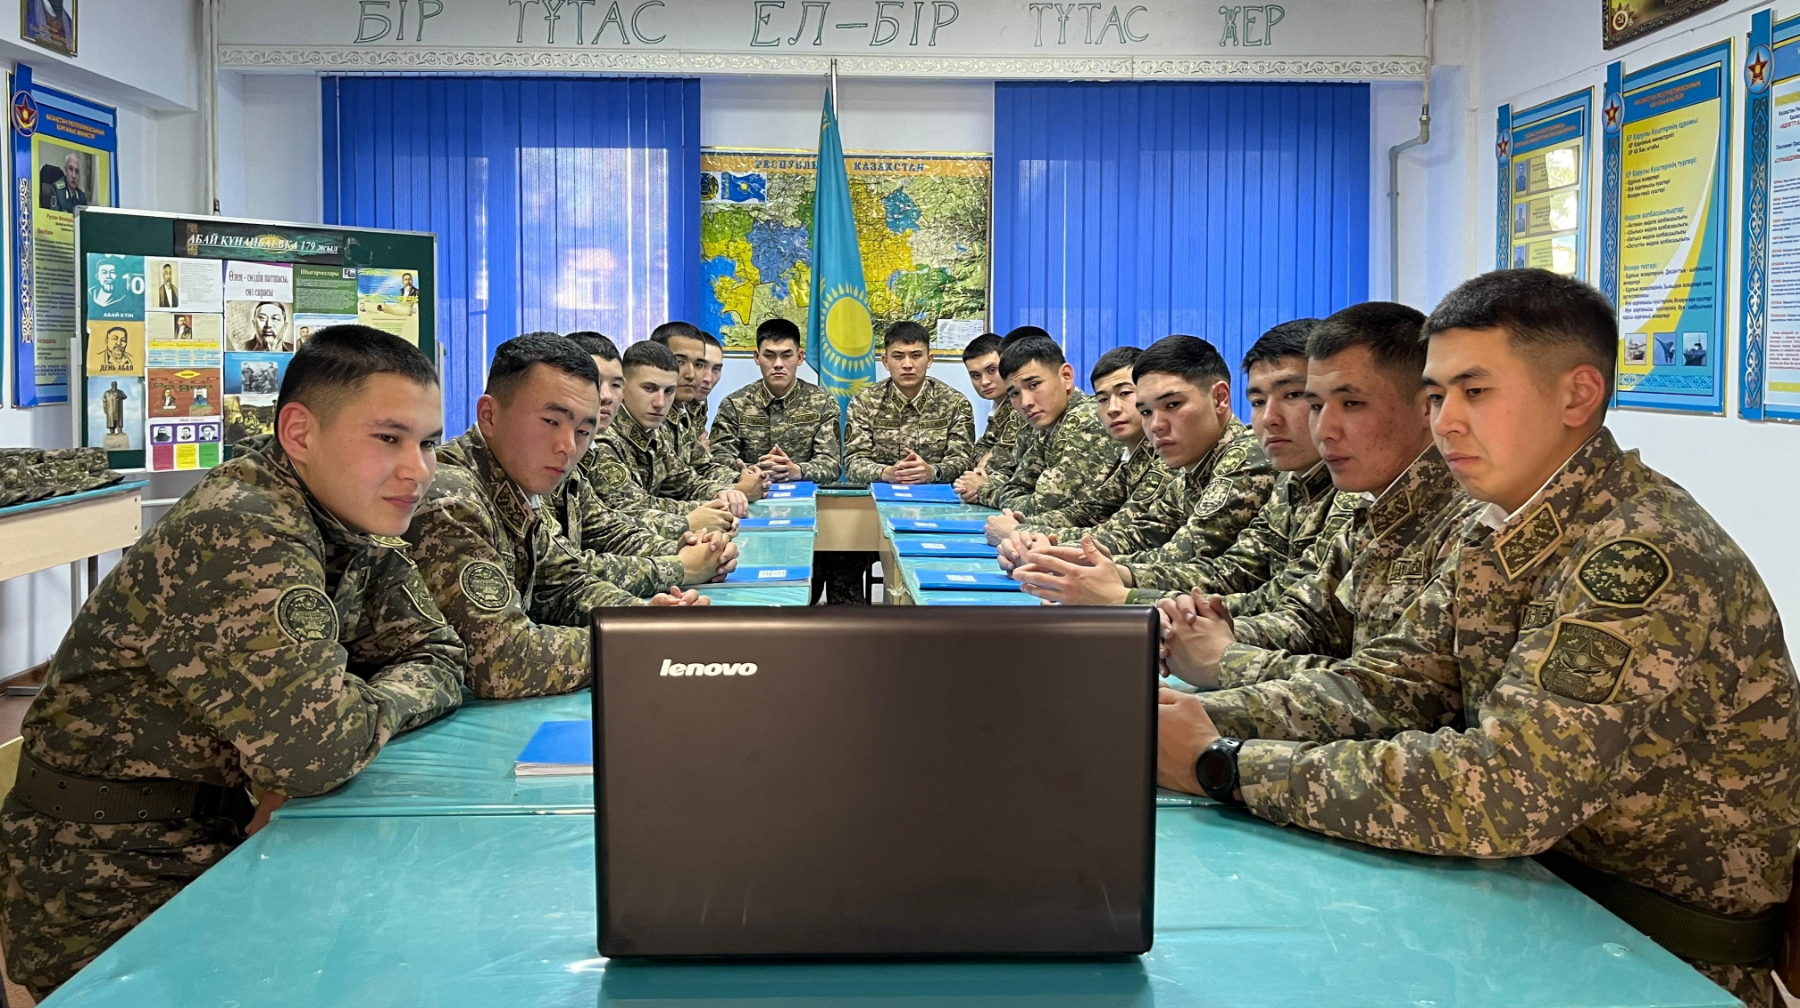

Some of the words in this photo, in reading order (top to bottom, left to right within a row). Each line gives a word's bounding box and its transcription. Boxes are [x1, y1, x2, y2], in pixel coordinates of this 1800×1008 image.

[353, 0, 444, 43] БІР
[508, 0, 666, 45] ТҰТАС
[1029, 3, 1149, 47] ТҰТАС
[755, 159, 818, 170] РЕСПУБЛИ
[854, 161, 924, 172] КАЗАХСТАН
[187, 232, 219, 245] АБАЙ
[300, 241, 316, 251] 179
[317, 244, 338, 253] жыл
[100, 364, 116, 372] ДЕНЬ
[660, 659, 758, 676] lenovo
